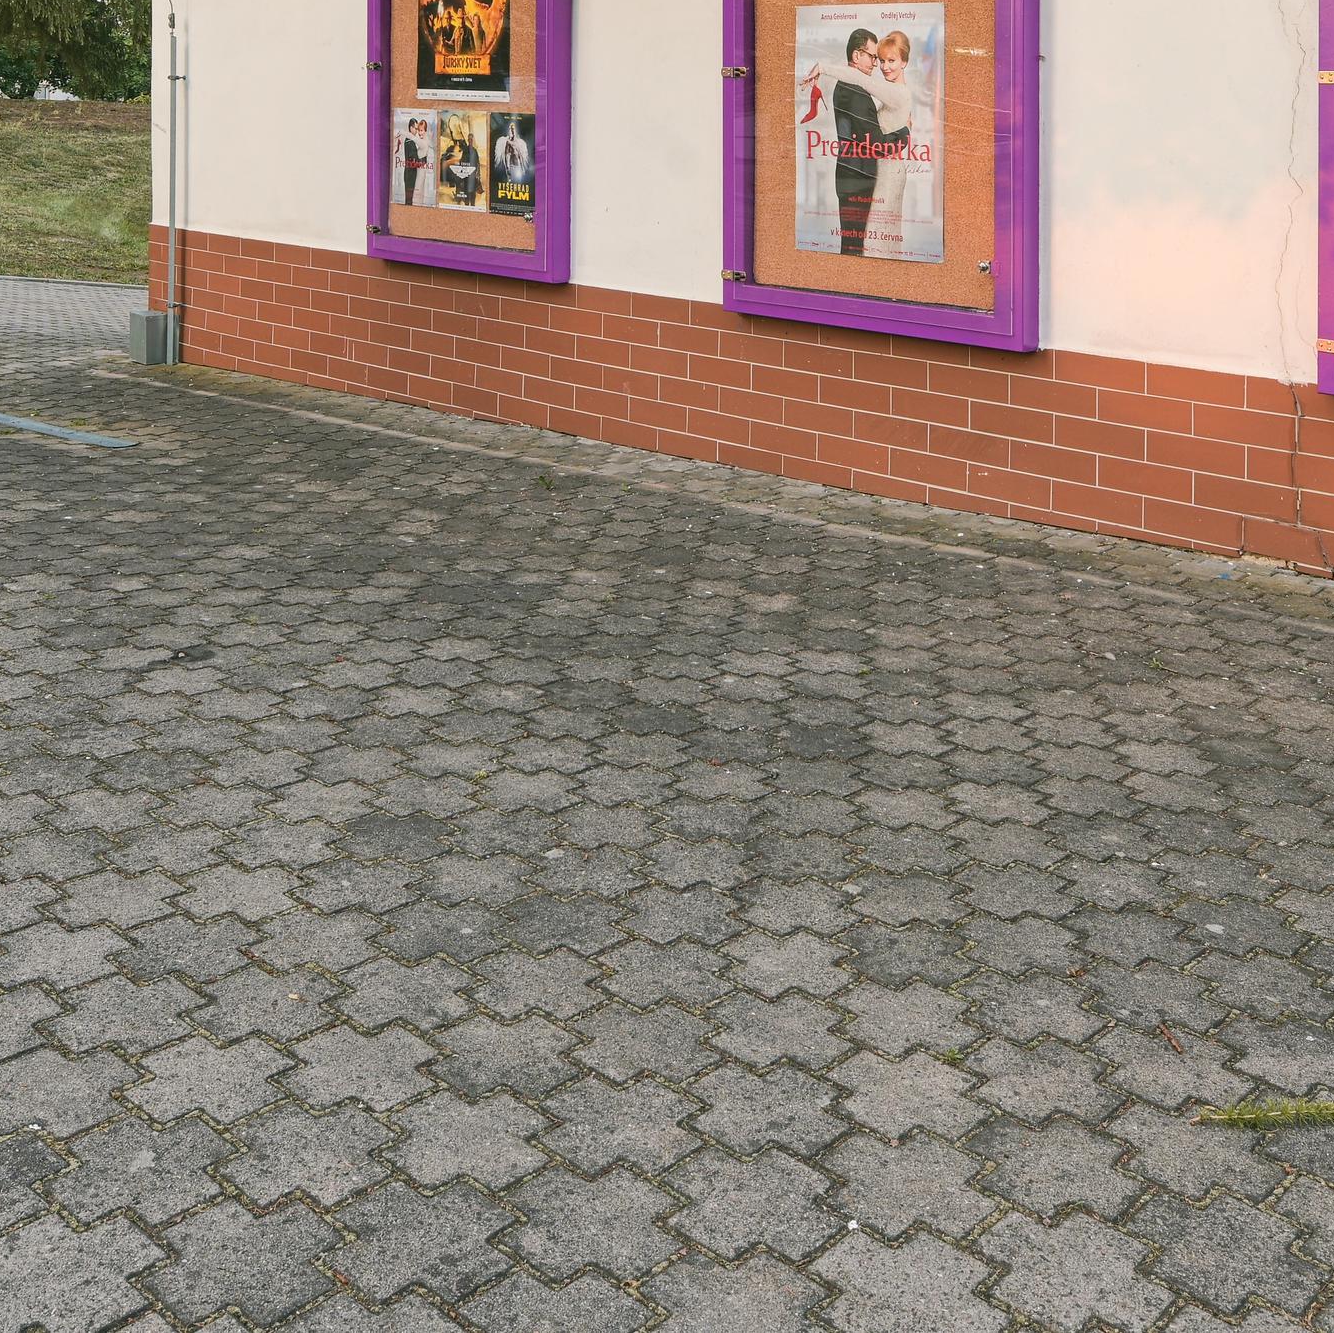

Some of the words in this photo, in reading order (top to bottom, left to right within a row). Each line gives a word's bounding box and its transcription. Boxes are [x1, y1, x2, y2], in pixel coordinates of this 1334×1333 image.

[805, 130, 932, 162] Prezidentka
[498, 189, 530, 201] FYLM
[835, 227, 858, 238] kinech
[868, 230, 880, 240] 23.
[880, 231, 903, 243] června
